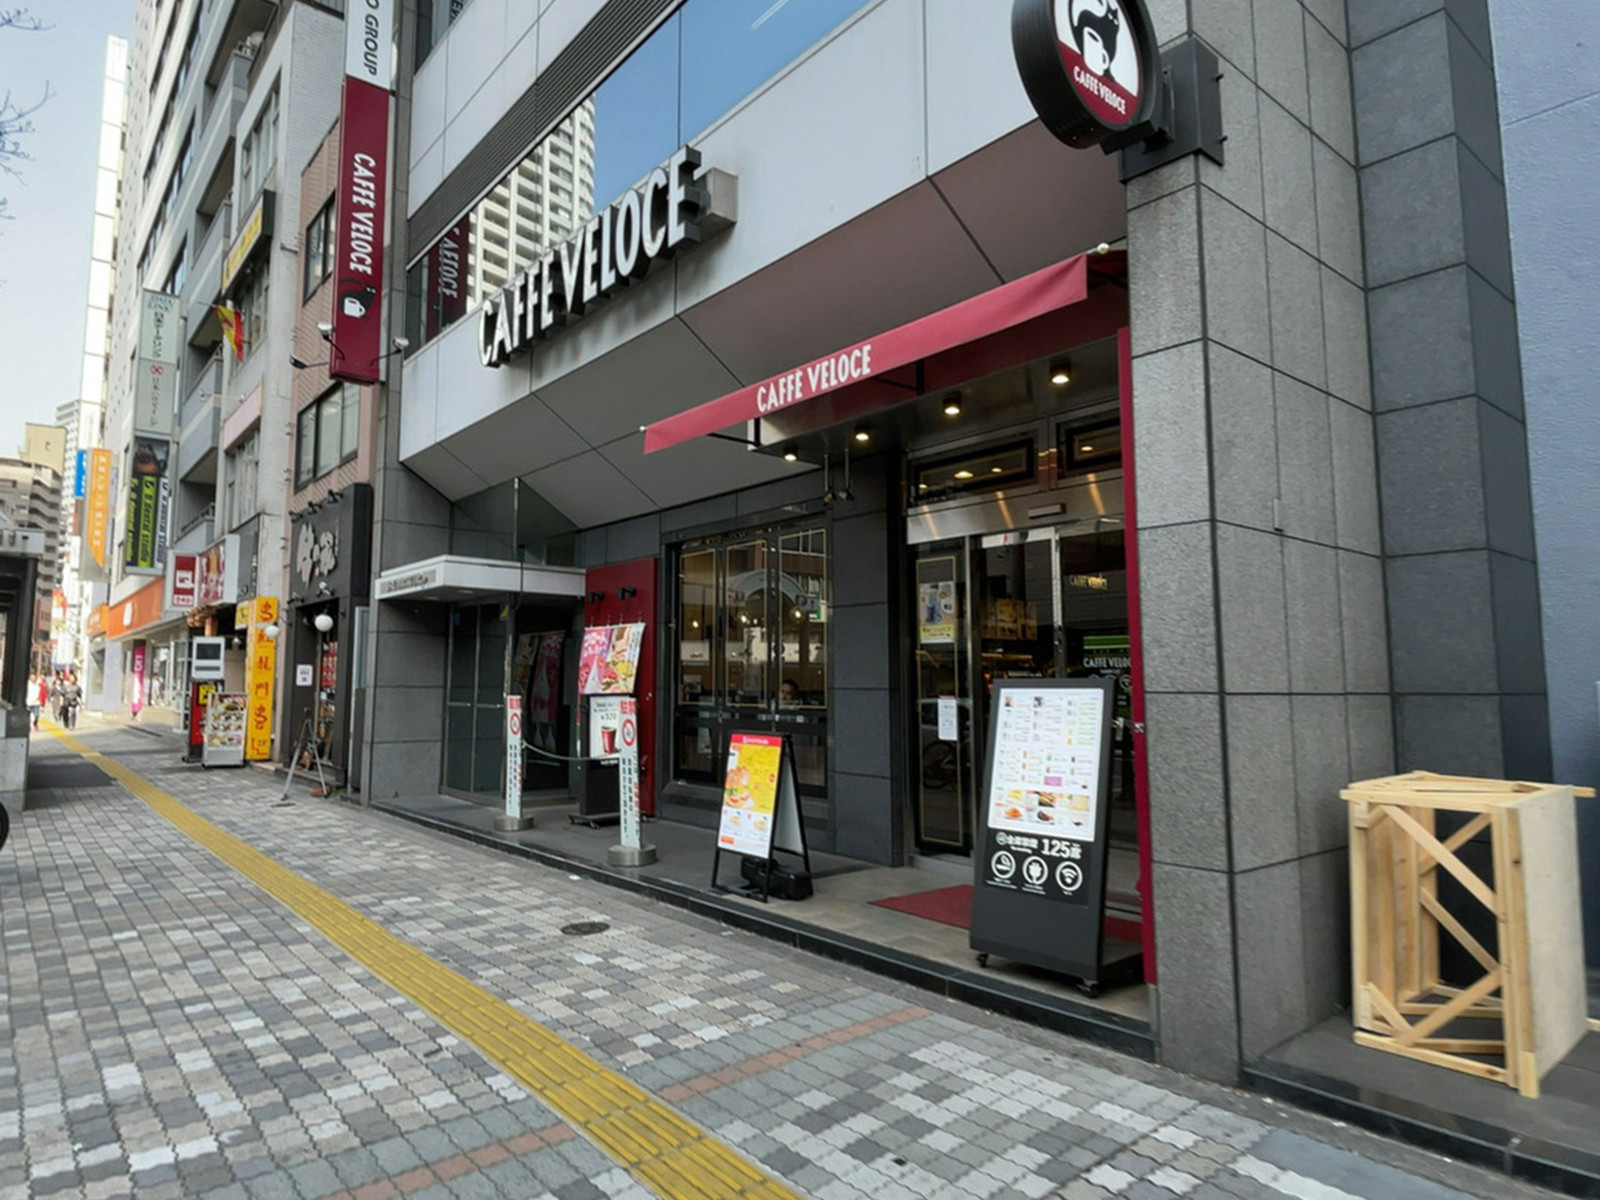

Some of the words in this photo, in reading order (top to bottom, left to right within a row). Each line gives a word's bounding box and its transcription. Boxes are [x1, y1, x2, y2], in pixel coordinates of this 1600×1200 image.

[363, 13, 379, 77] GROUP
[349, 211, 374, 275] VELOCE
[479, 248, 556, 368] CAFFE
[560, 144, 697, 314] VELOCE
[806, 343, 872, 393] VELOCE
